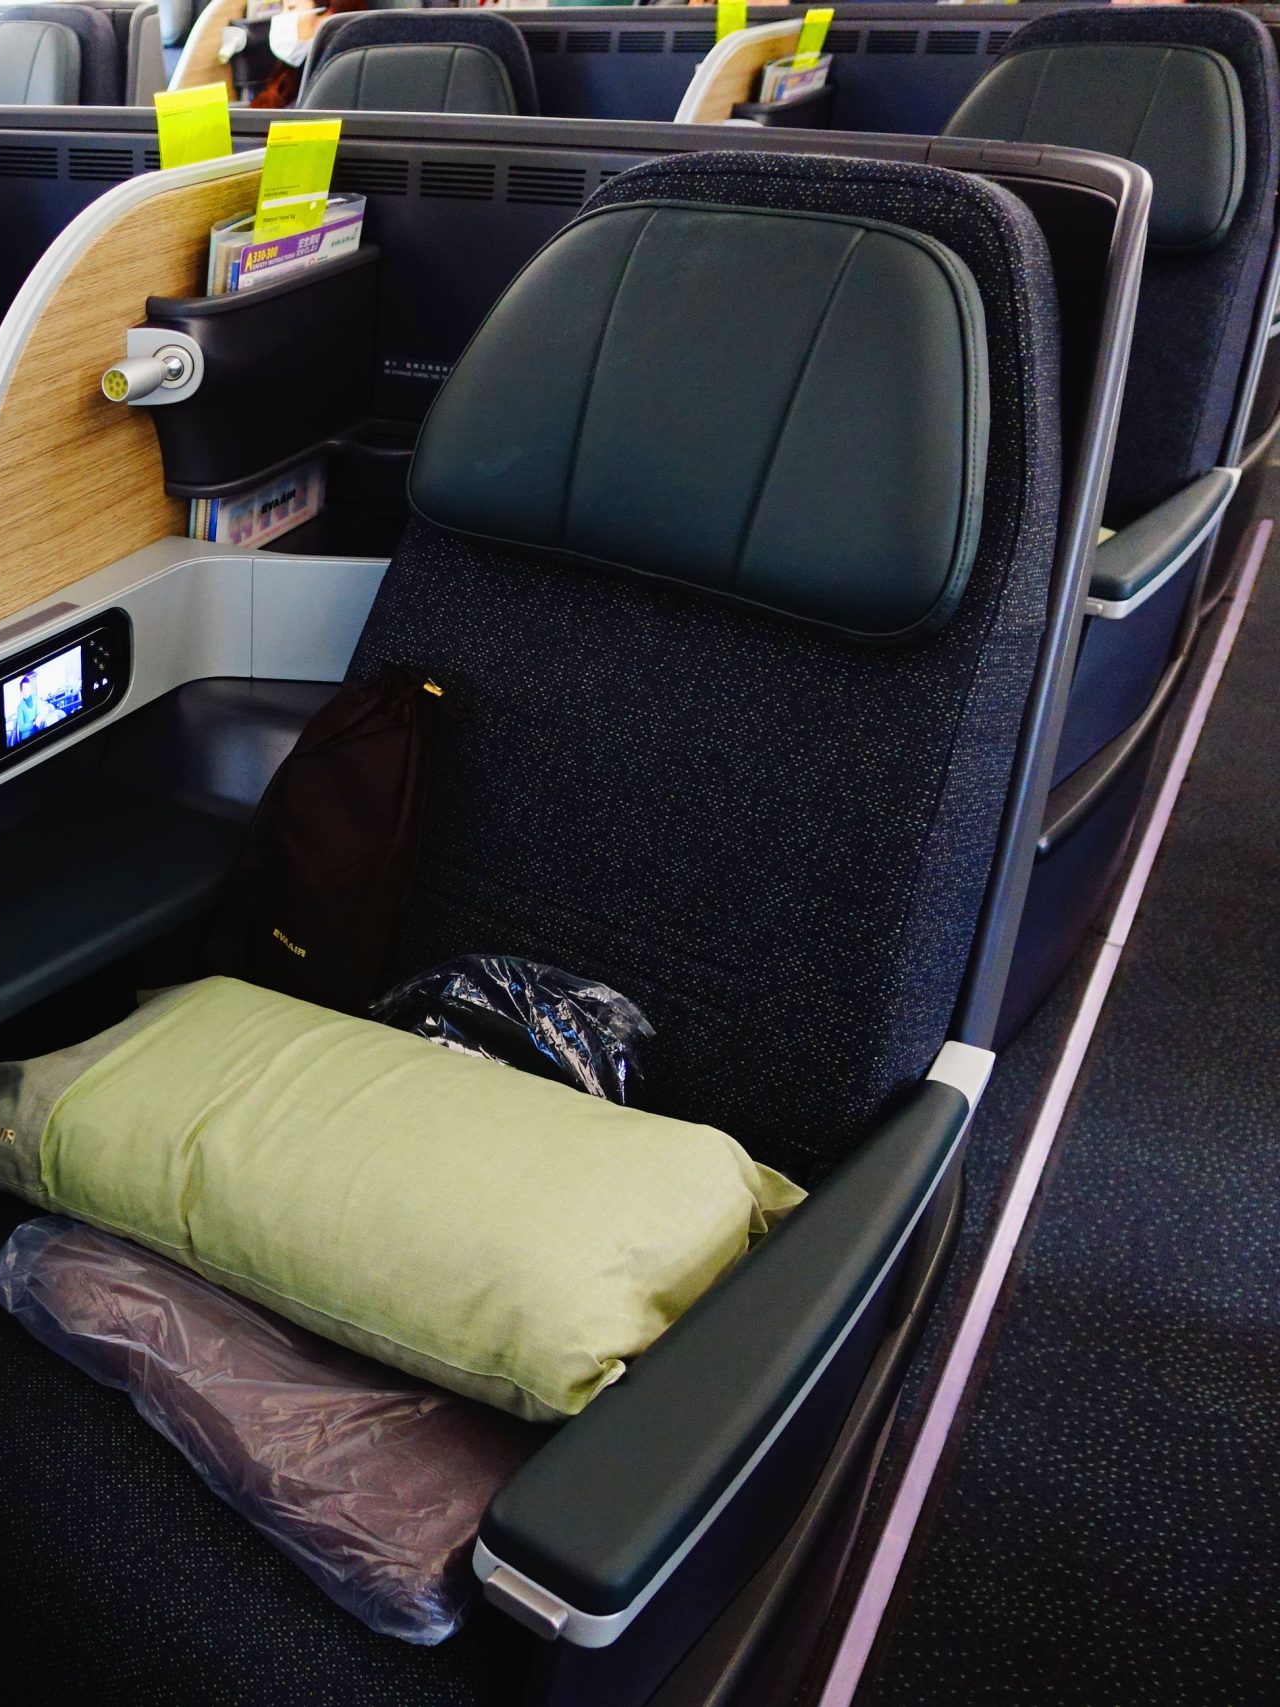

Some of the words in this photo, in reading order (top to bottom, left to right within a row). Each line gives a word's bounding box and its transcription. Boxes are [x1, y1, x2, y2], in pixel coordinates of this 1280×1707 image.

[245, 246, 279, 272] A330-300
[261, 497, 281, 514] EVA
[281, 488, 297, 506] AIR
